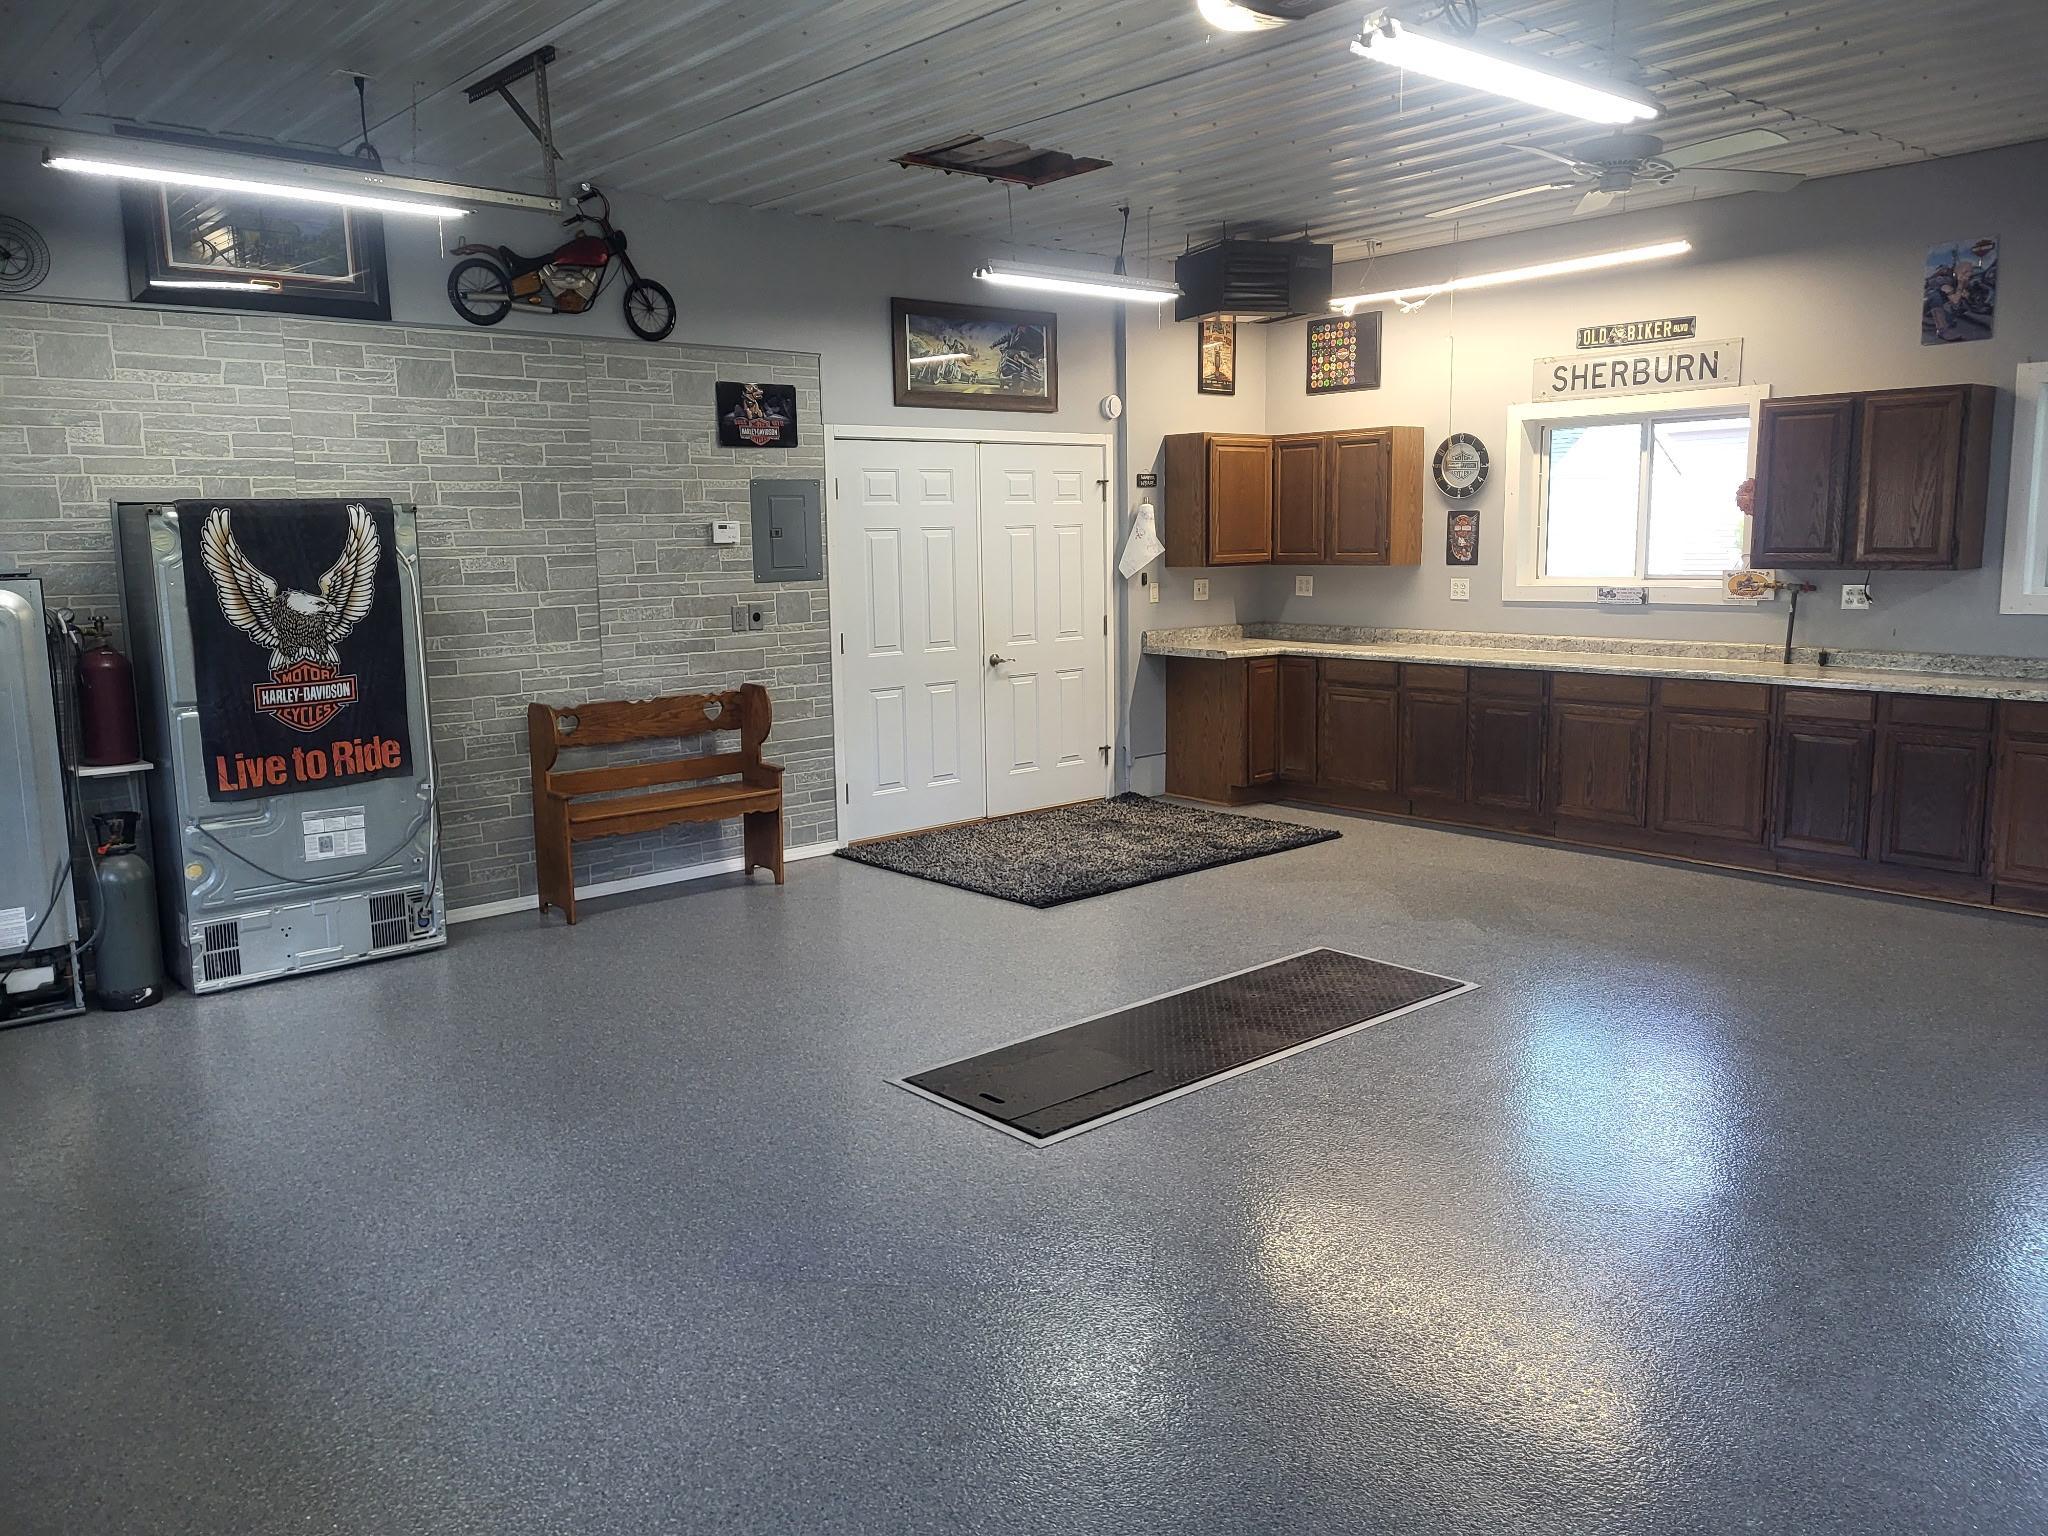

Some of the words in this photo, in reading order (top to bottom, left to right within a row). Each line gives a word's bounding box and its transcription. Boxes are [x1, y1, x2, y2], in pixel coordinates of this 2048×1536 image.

[1583, 329, 1607, 346] OLD
[1627, 321, 1672, 341] BIKER
[1673, 323, 1689, 334] BLVD
[1552, 350, 1719, 392] SHERBURN
[282, 666, 330, 683] MOTOR
[261, 682, 351, 706] HARLEY-DAVIDSON
[283, 705, 331, 726] CYCLES
[216, 752, 287, 792] Live
[292, 746, 328, 782] to
[331, 736, 402, 777] Ride
